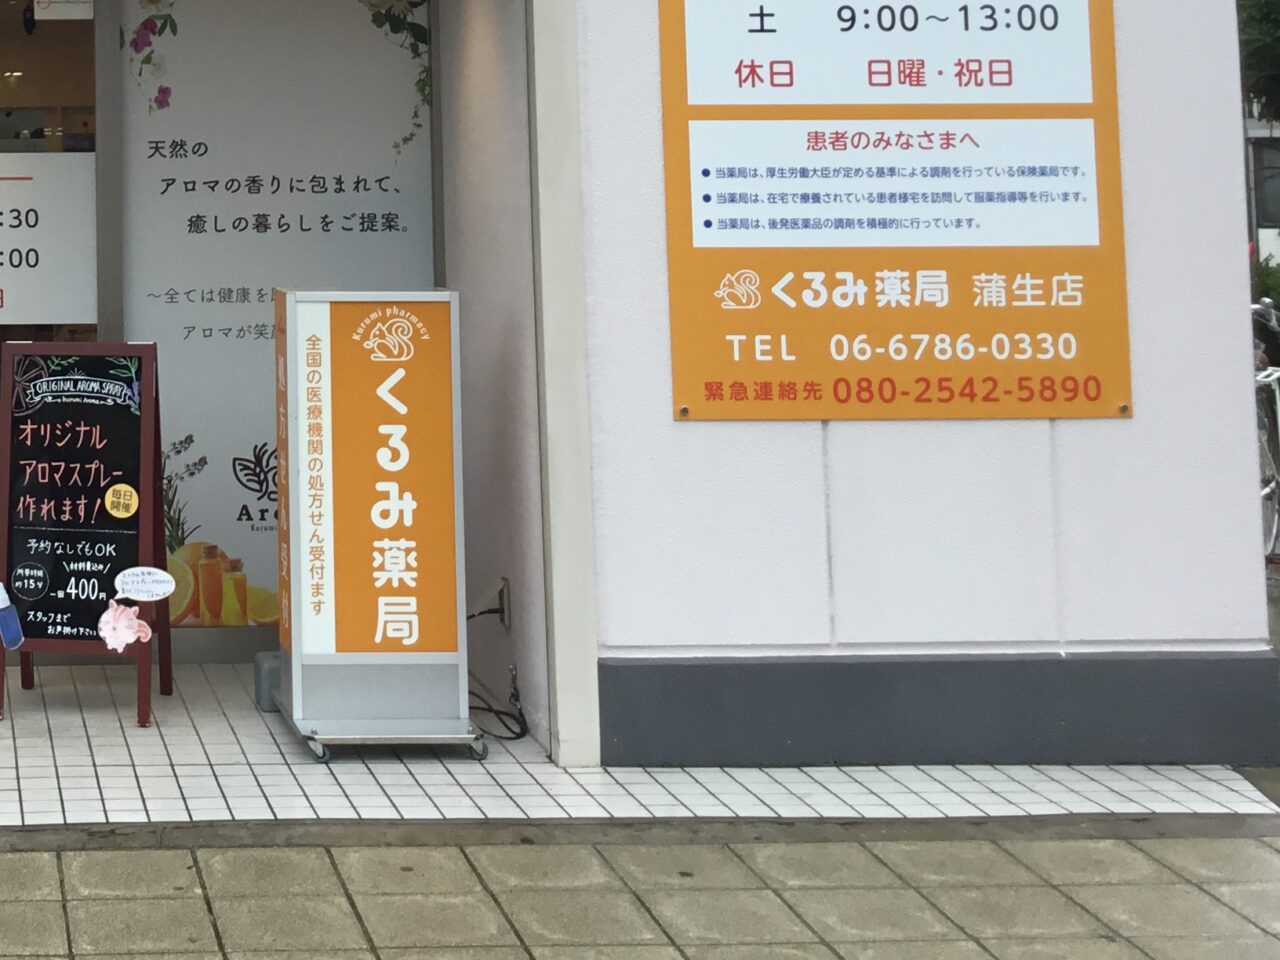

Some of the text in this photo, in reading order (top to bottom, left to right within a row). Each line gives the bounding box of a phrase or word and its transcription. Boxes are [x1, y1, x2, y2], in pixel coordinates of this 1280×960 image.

[748, 5, 777, 33] 土
[735, 58, 1013, 88] 休日 日曜・祝日
[147, 139, 209, 159] 天然の
[805, 130, 980, 151] 患者のみなさまへ
[160, 175, 403, 196] アロマの香りに包まれて、
[187, 212, 411, 234] 癒しの暮らしをご提案。
[147, 287, 276, 304] ～全ては健康を
[771, 269, 1084, 308] くるみ薬局 蒲生店
[352, 306, 430, 341] Kurumi pharmacy
[725, 333, 1077, 361] TEL 06-6786-0330
[36, 379, 124, 396] ORIGINAL AROMA SPRAY
[704, 376, 1102, 404] 緊急連絡先 080-2542-5890
[18, 419, 107, 449] オリジナル
[19, 459, 123, 487] アロマスプレー
[305, 334, 326, 616] 全国の医療機関の処方せん受付ます
[111, 488, 133, 501] 毎日
[370, 367, 419, 645] くるみ薬局
[110, 501, 132, 514] 開催
[27, 539, 116, 556] 予約なしでもOK
[27, 611, 71, 623] スタッフまで
